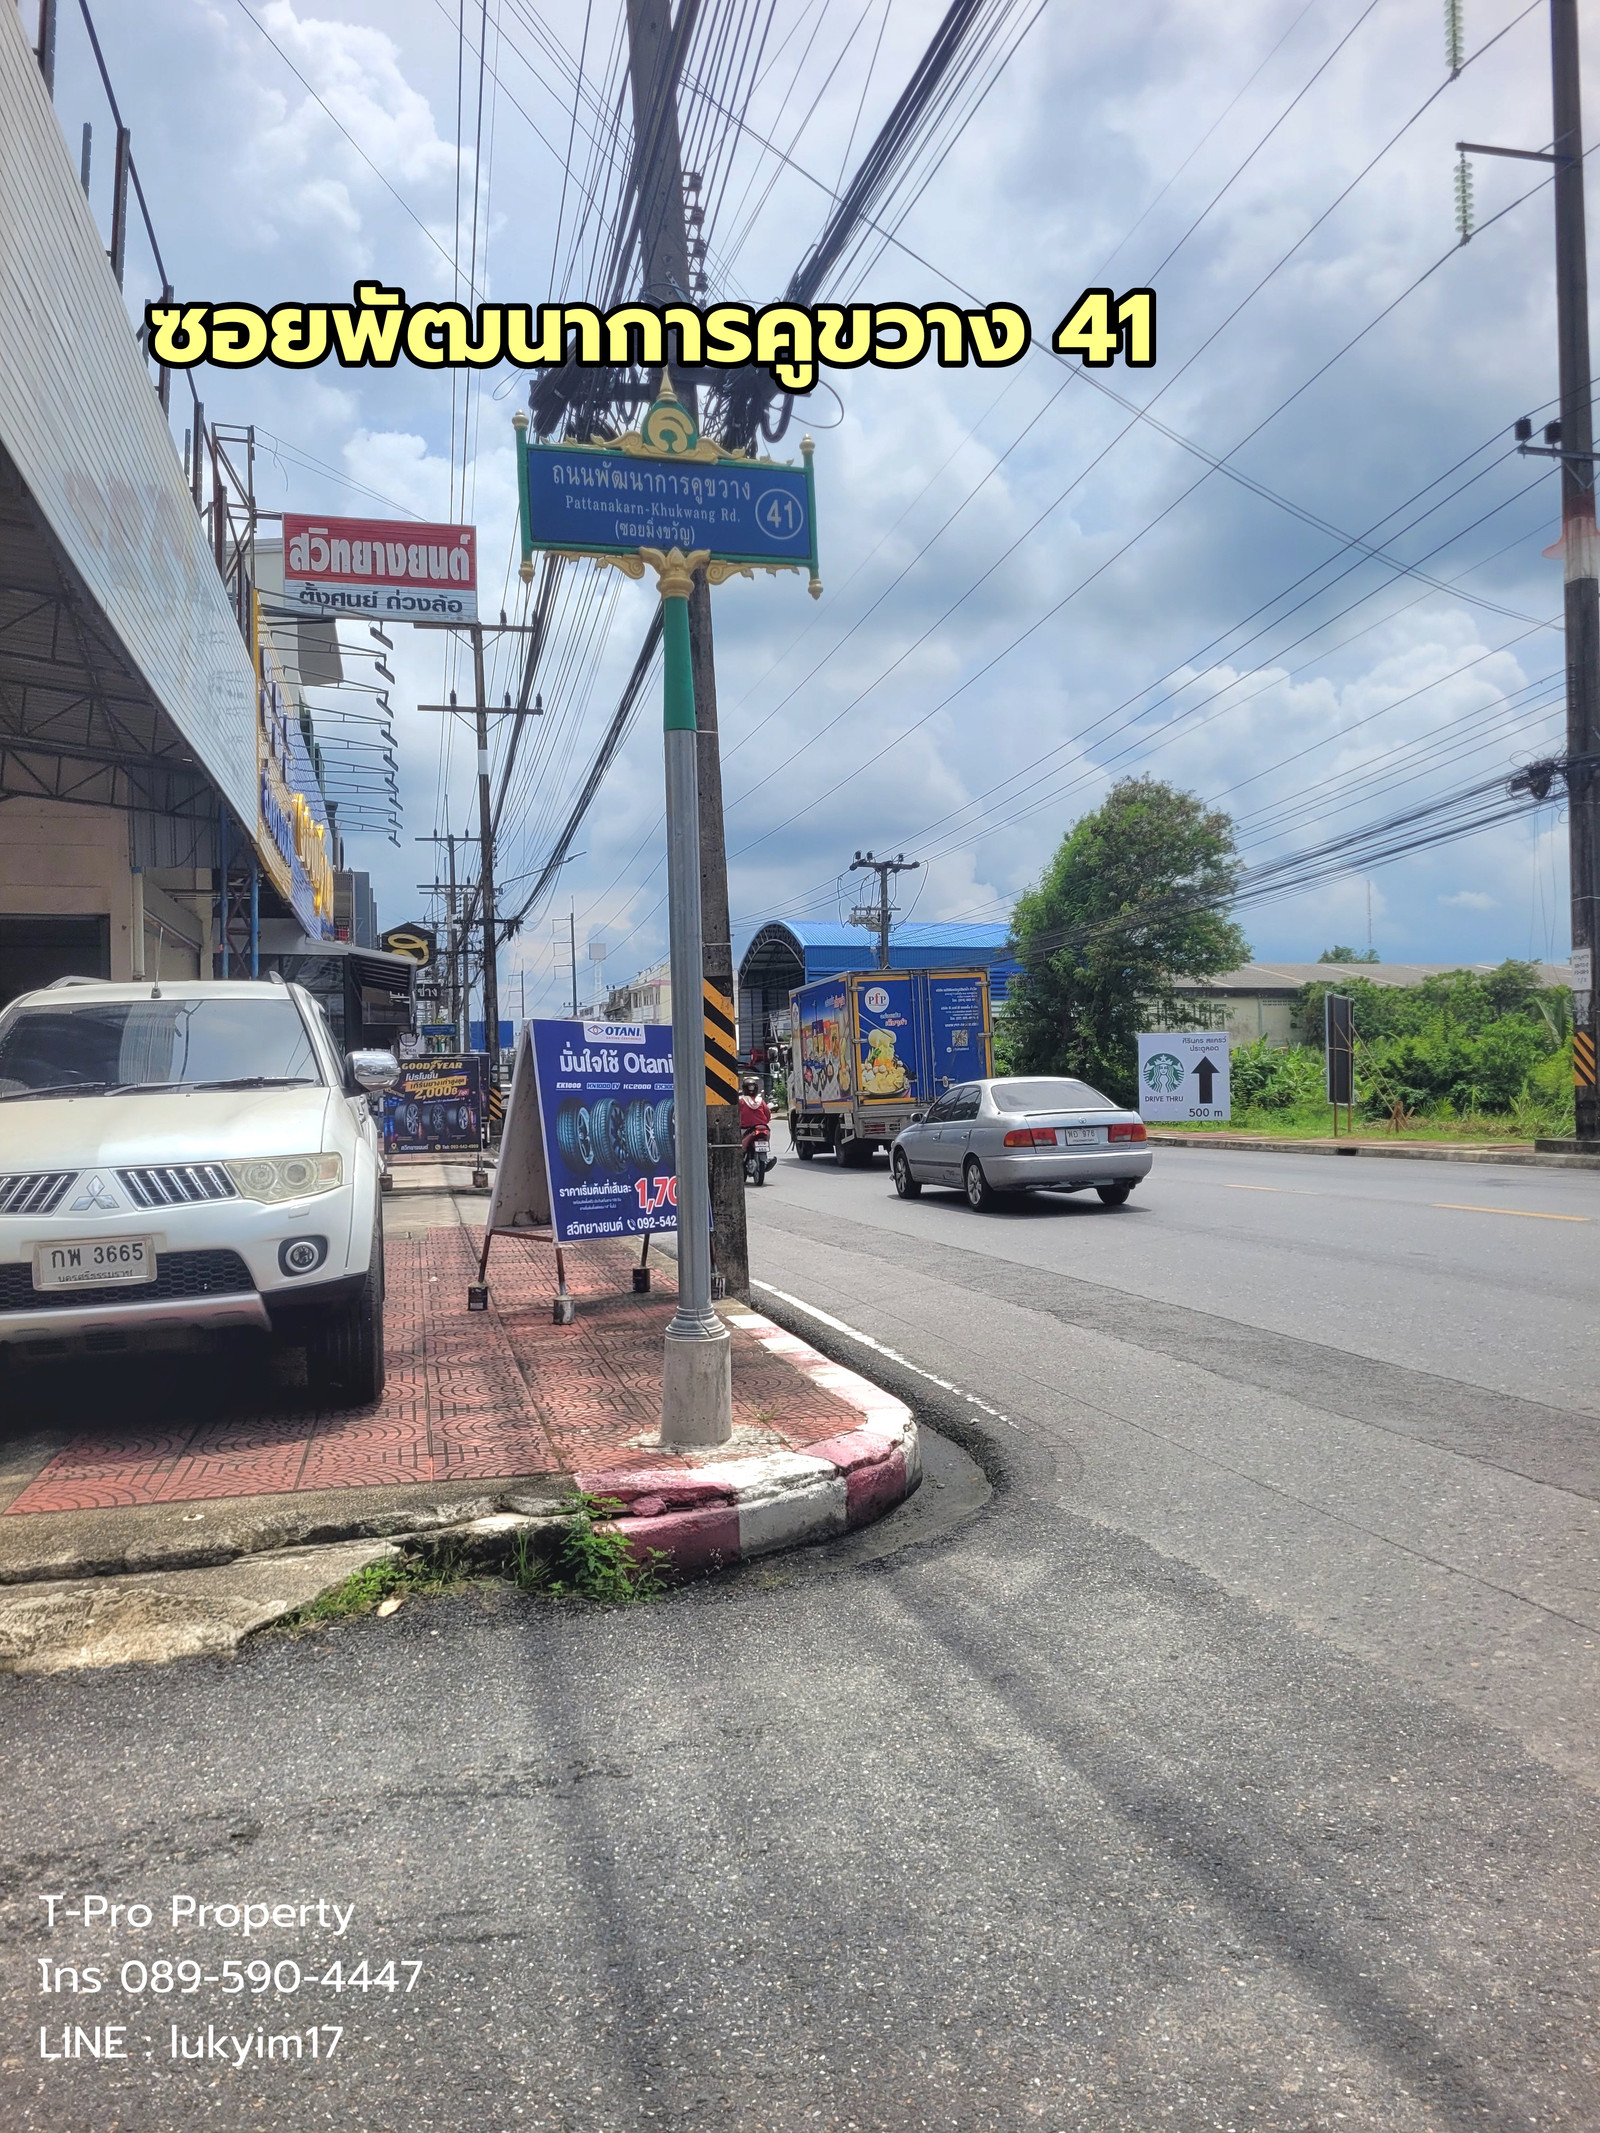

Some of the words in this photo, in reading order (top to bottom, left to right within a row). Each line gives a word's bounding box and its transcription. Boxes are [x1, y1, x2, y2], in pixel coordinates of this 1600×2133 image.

[552, 461, 751, 505] ถนนพัฒนาการคูขวาง
[565, 495, 716, 523] Pattanakarn-Khukwang
[720, 508, 741, 523] Rd.
[766, 499, 794, 530] 41
[289, 527, 471, 581] สวิทยางยนต์
[386, 589, 463, 613] ถ่วงล้อ
[605, 1026, 641, 1037] OTANI
[401, 1060, 463, 1071] GOODYEAR
[559, 1041, 620, 1074] มั่นใจใช้
[1188, 1107, 1210, 1118] 500
[1213, 1110, 1223, 1118] m
[635, 1177, 677, 1214] 1,70
[566, 1216, 624, 1236] สวิทยางยนต์
[636, 1214, 678, 1230] 092-542
[51, 1247, 81, 1269] กพ
[93, 1242, 144, 1264] 3665
